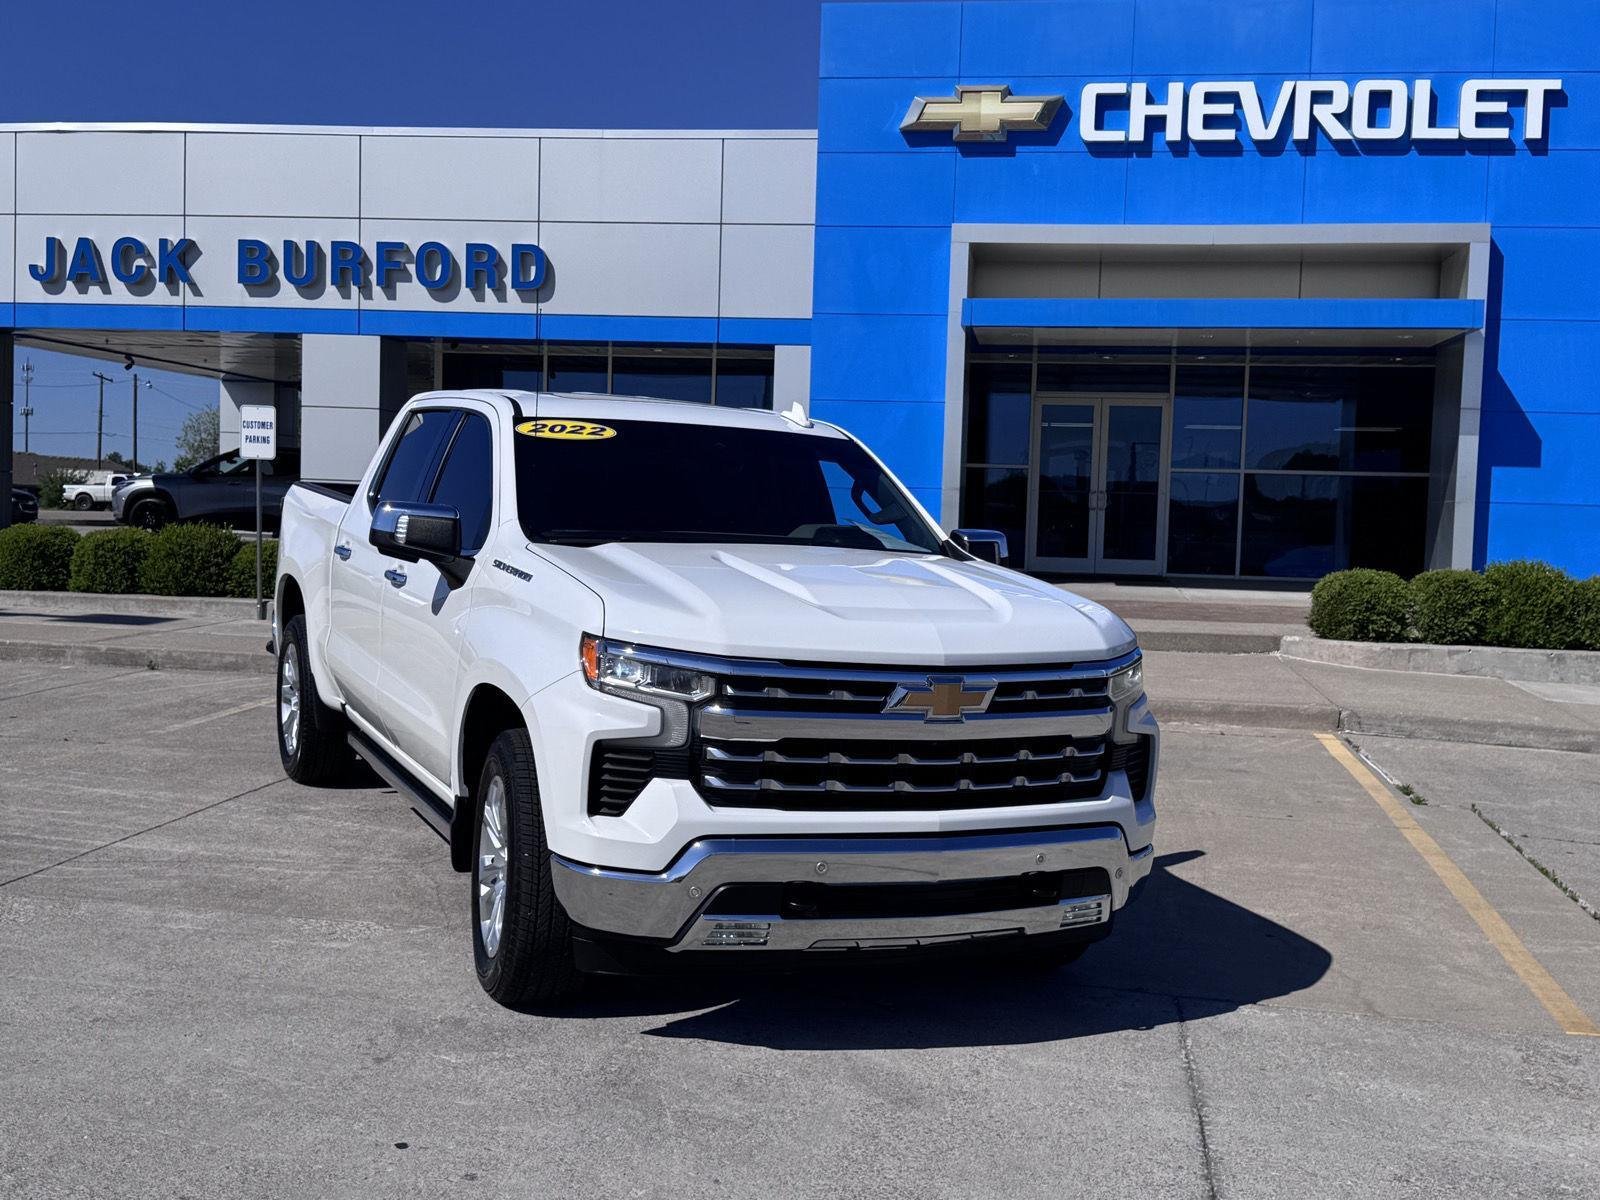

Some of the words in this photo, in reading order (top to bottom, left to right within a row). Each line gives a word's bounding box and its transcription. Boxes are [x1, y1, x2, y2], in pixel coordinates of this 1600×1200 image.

[1079, 79, 1563, 141] CHEVROLET
[28, 236, 194, 284] JACK
[237, 239, 547, 291] BURFORD
[242, 420, 274, 430] CUSTOMER
[527, 423, 607, 437] 2022
[245, 434, 271, 444] PARKING
